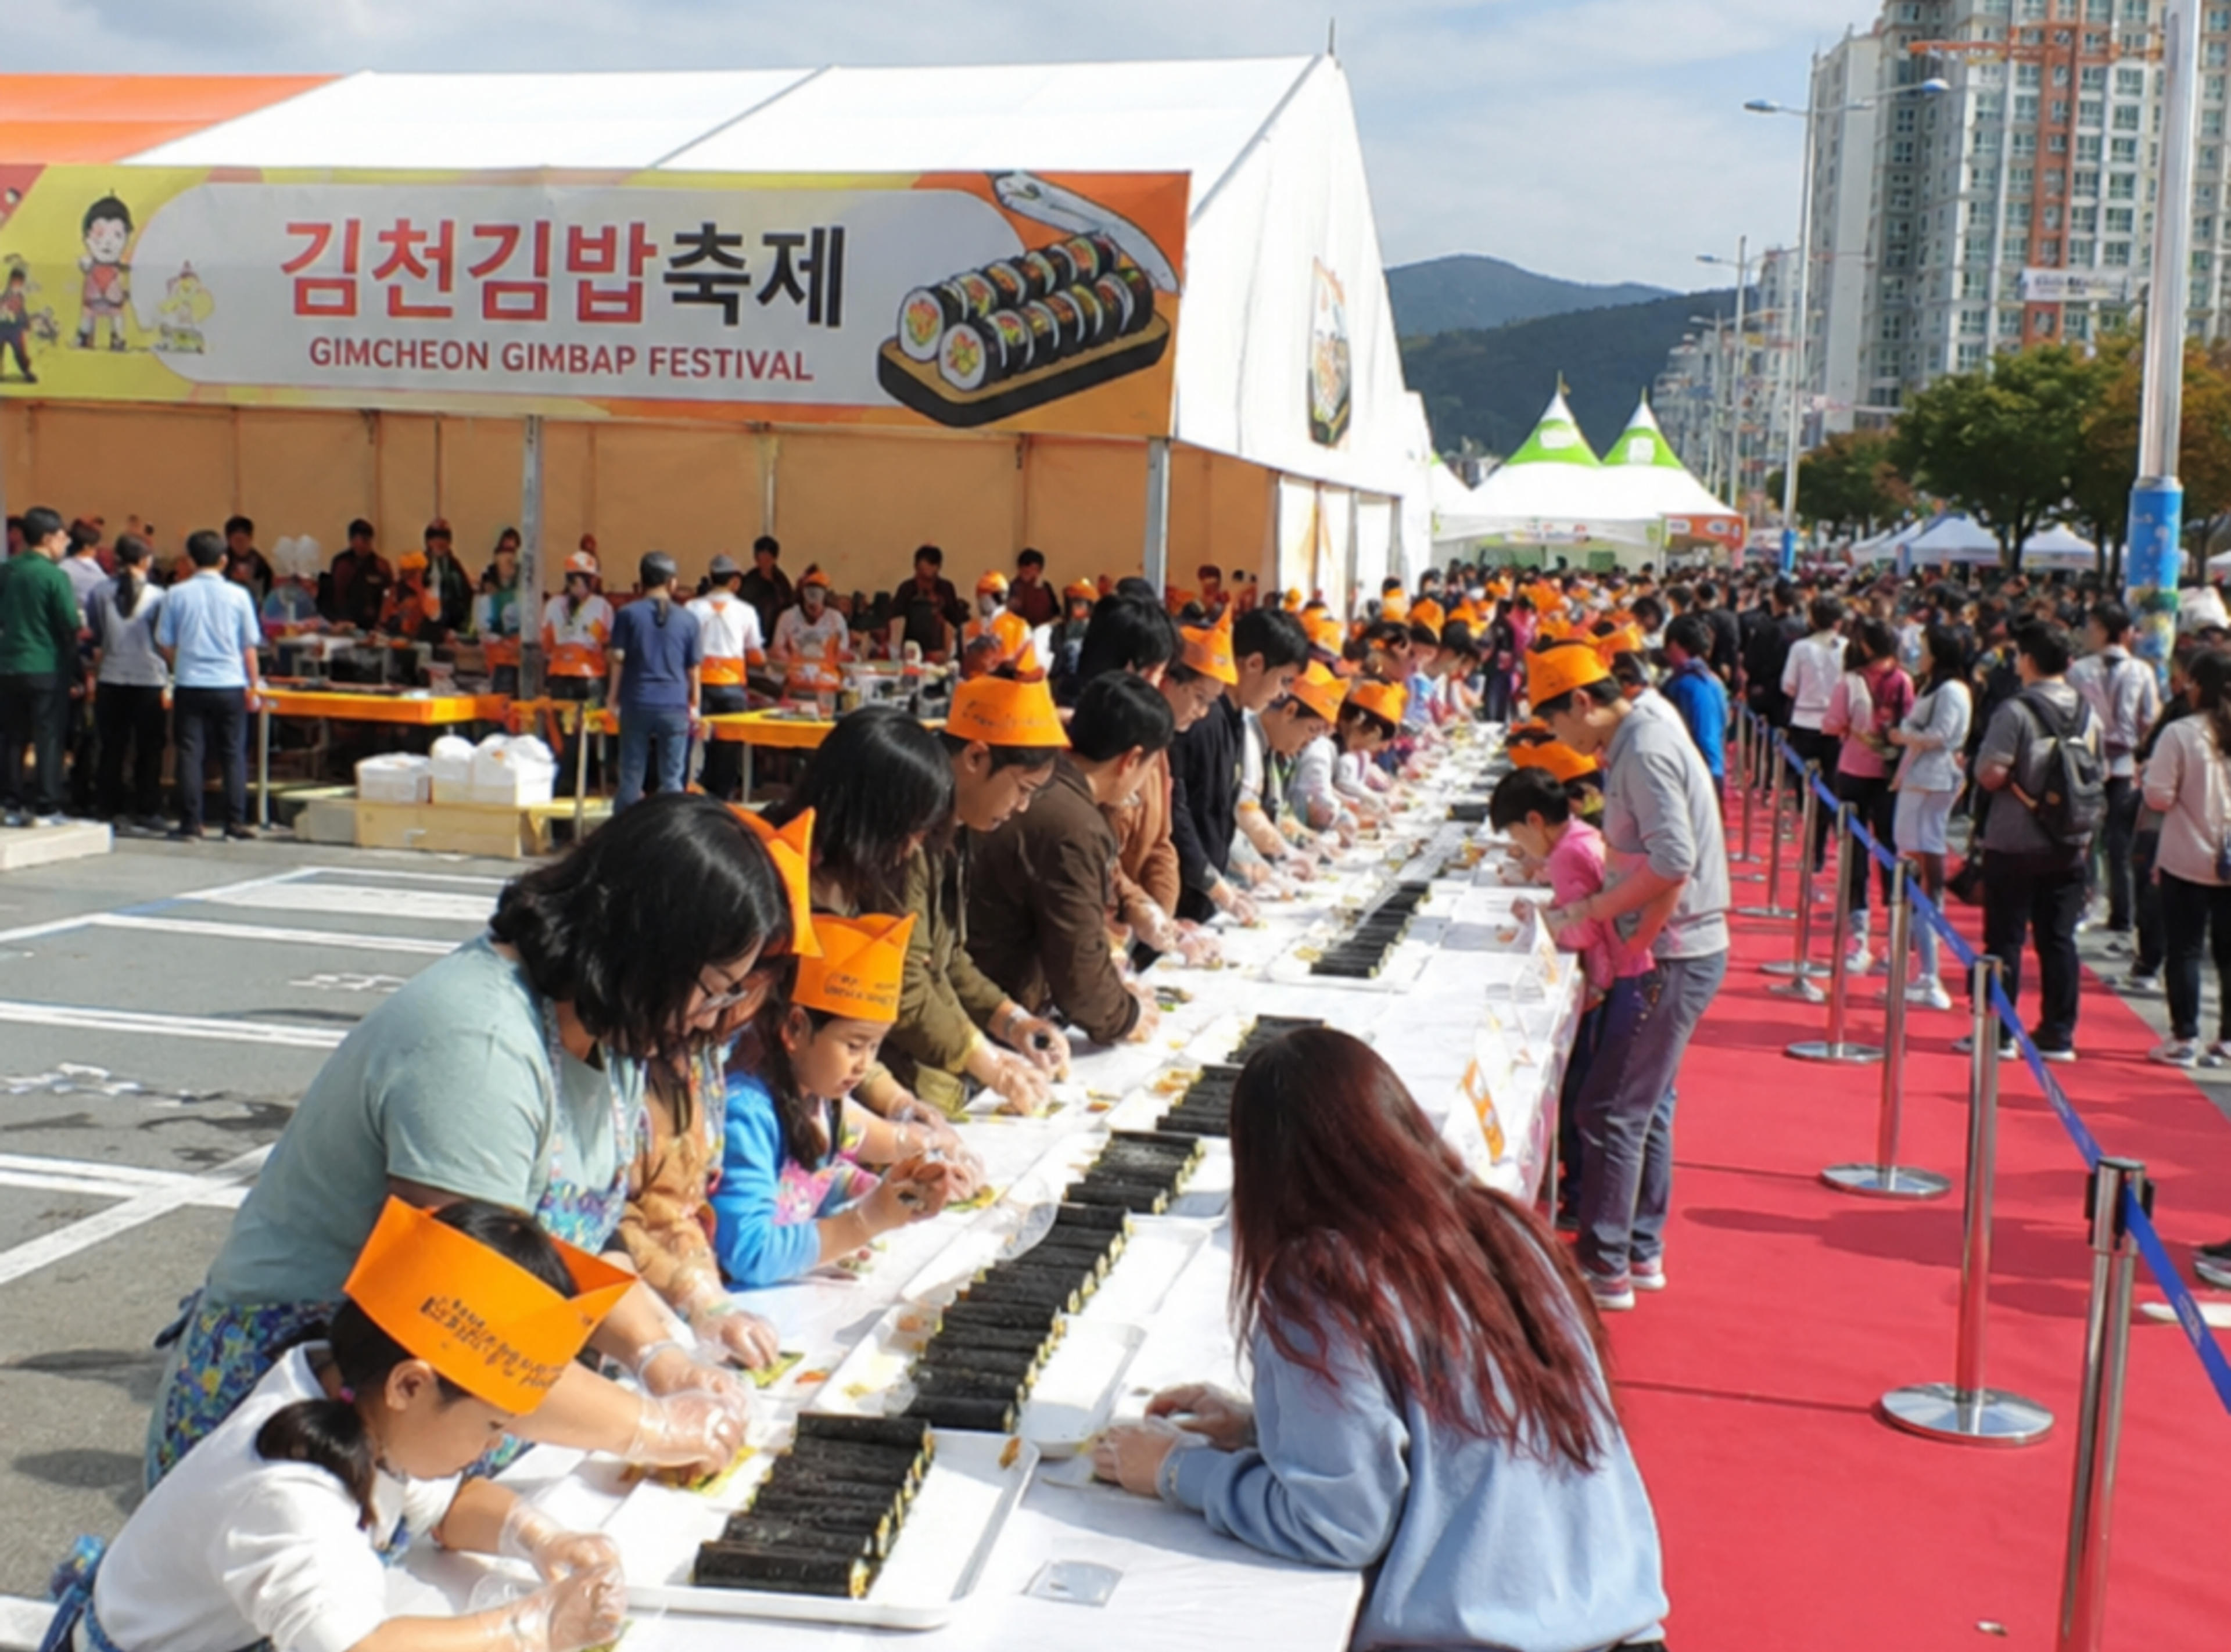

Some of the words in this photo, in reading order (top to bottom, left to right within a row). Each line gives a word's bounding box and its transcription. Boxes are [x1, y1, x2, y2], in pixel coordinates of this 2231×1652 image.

[281, 218, 845, 328] 김천김밥축제
[310, 337, 488, 371] GIMCHEON
[501, 342, 636, 374] GIMBAP
[648, 347, 813, 381] FESTIVAL
